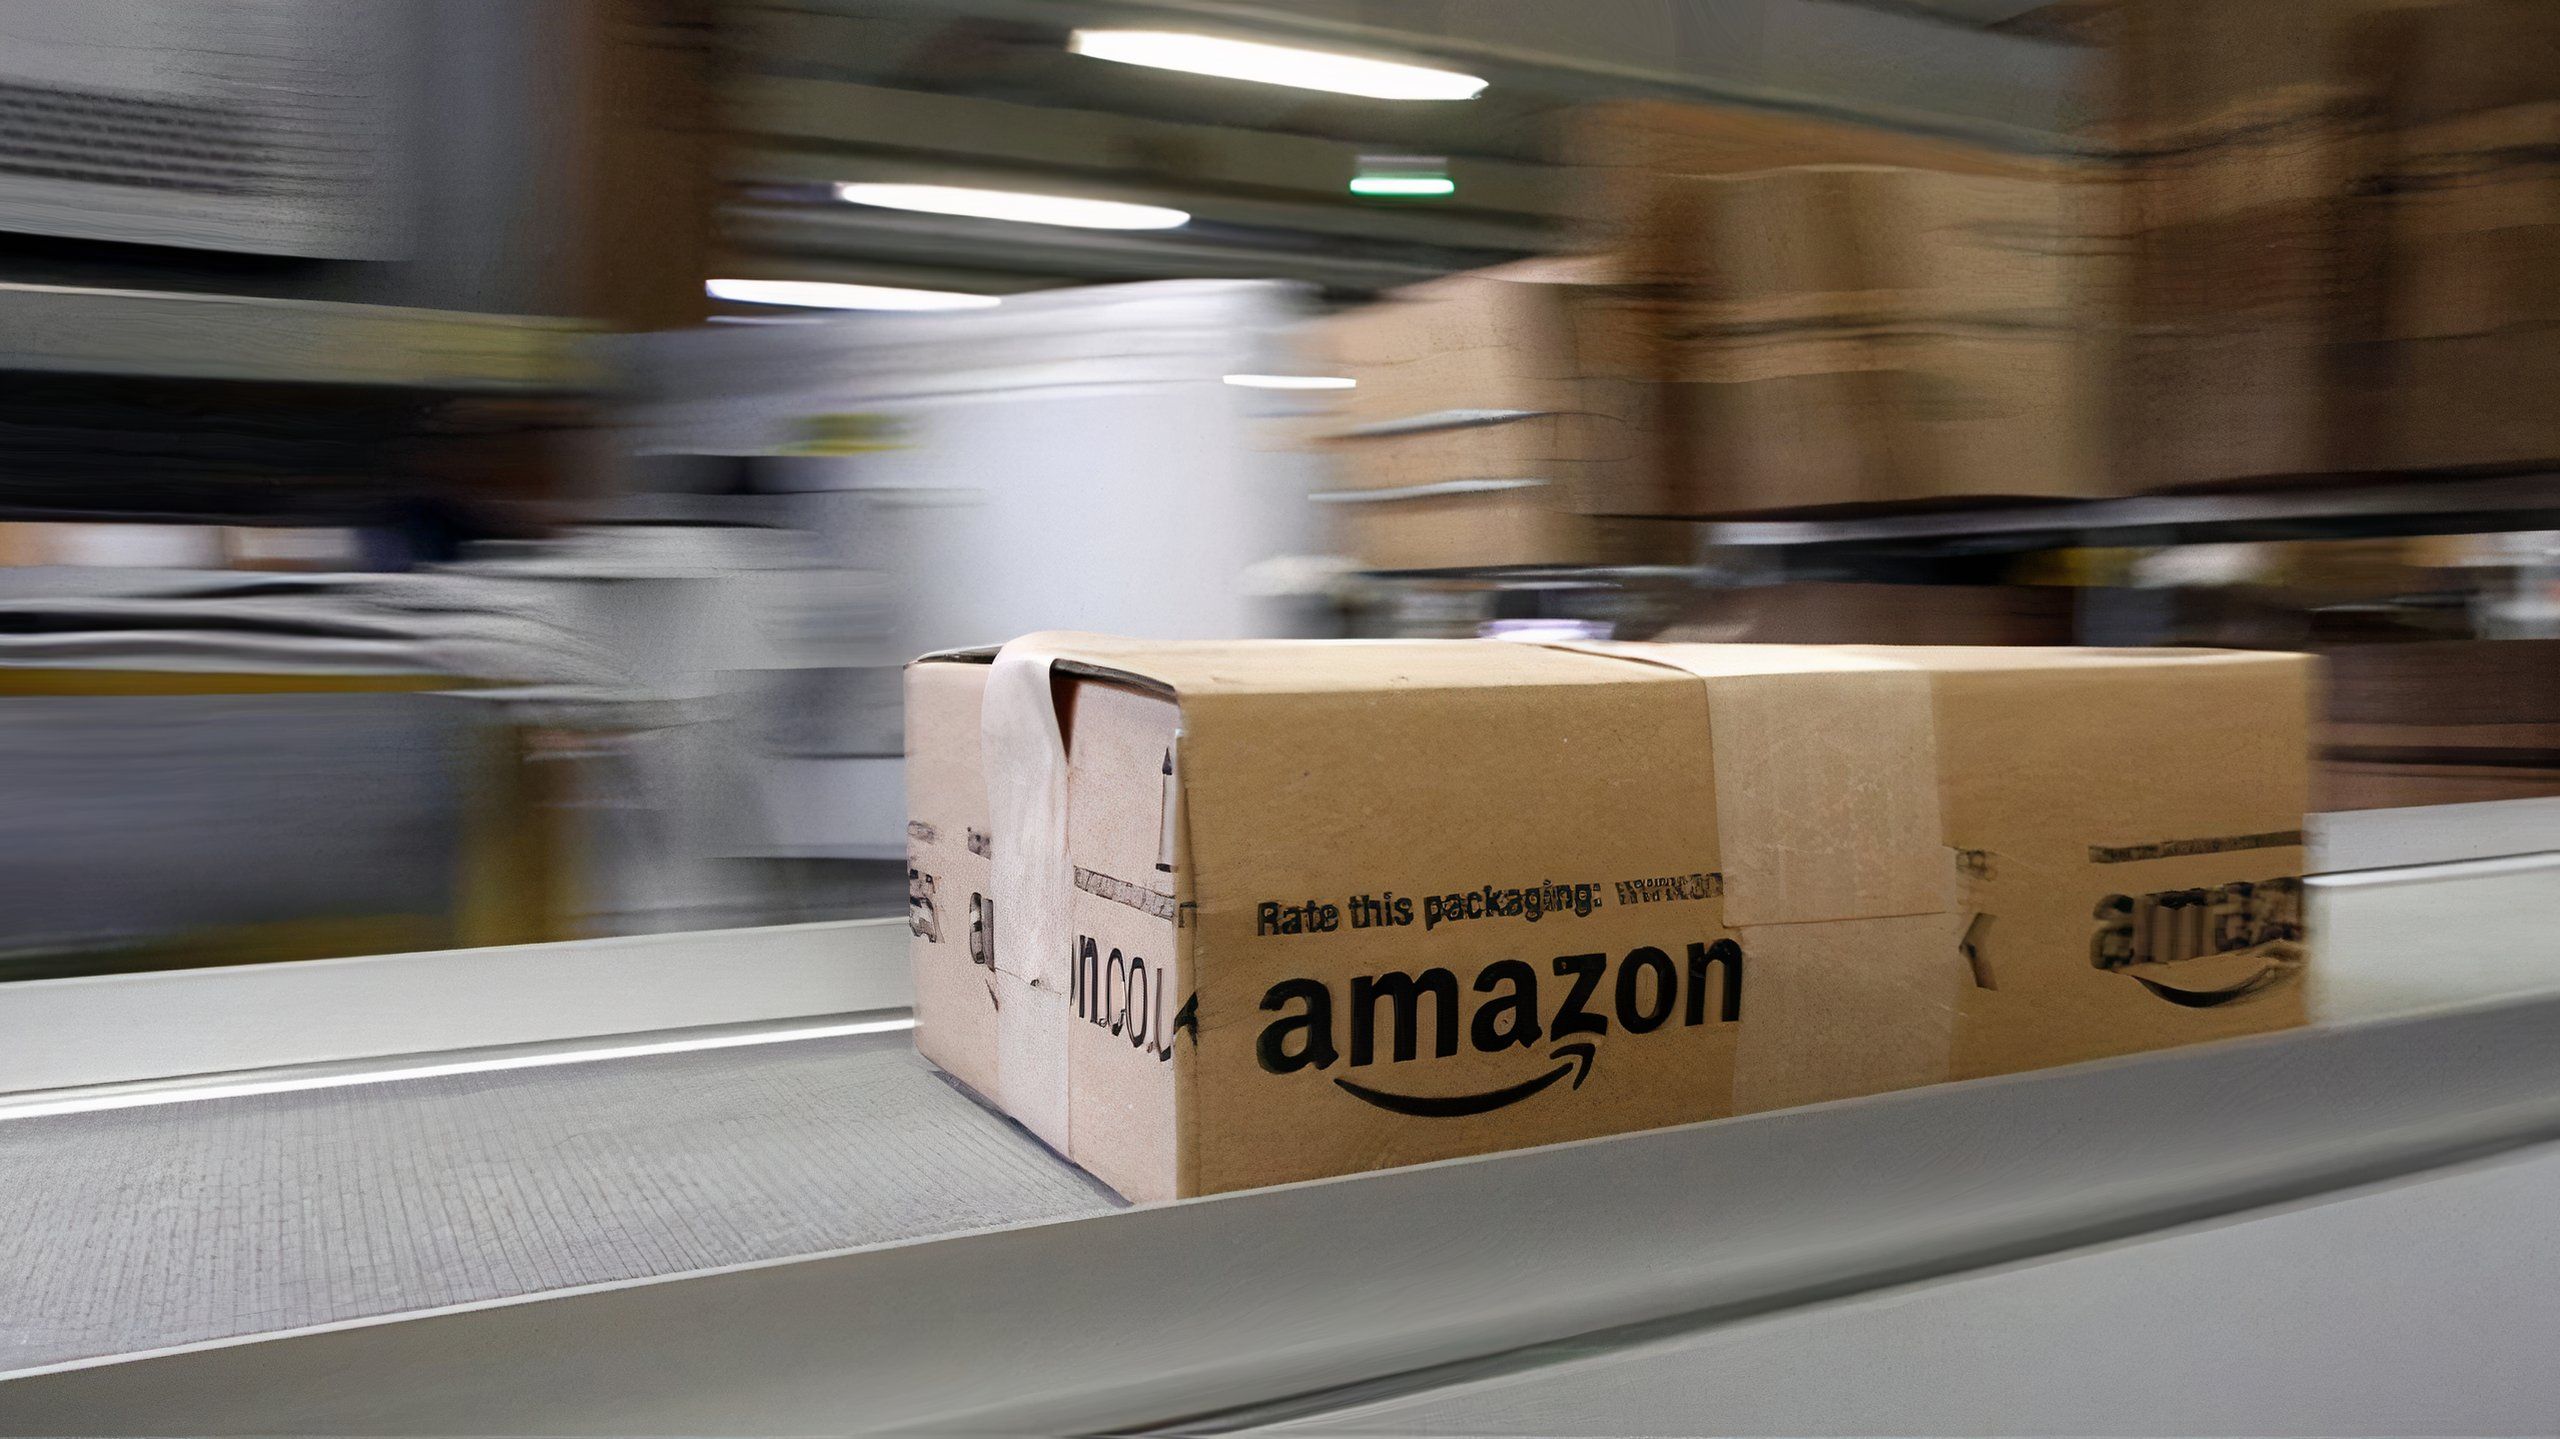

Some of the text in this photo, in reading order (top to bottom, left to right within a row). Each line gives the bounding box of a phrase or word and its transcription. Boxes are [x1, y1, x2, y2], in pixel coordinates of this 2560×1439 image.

[1257, 900, 1339, 936] Rate
[1349, 891, 1414, 928] this
[1424, 879, 1603, 930] packaging:
[1256, 938, 1743, 1075] amazon
